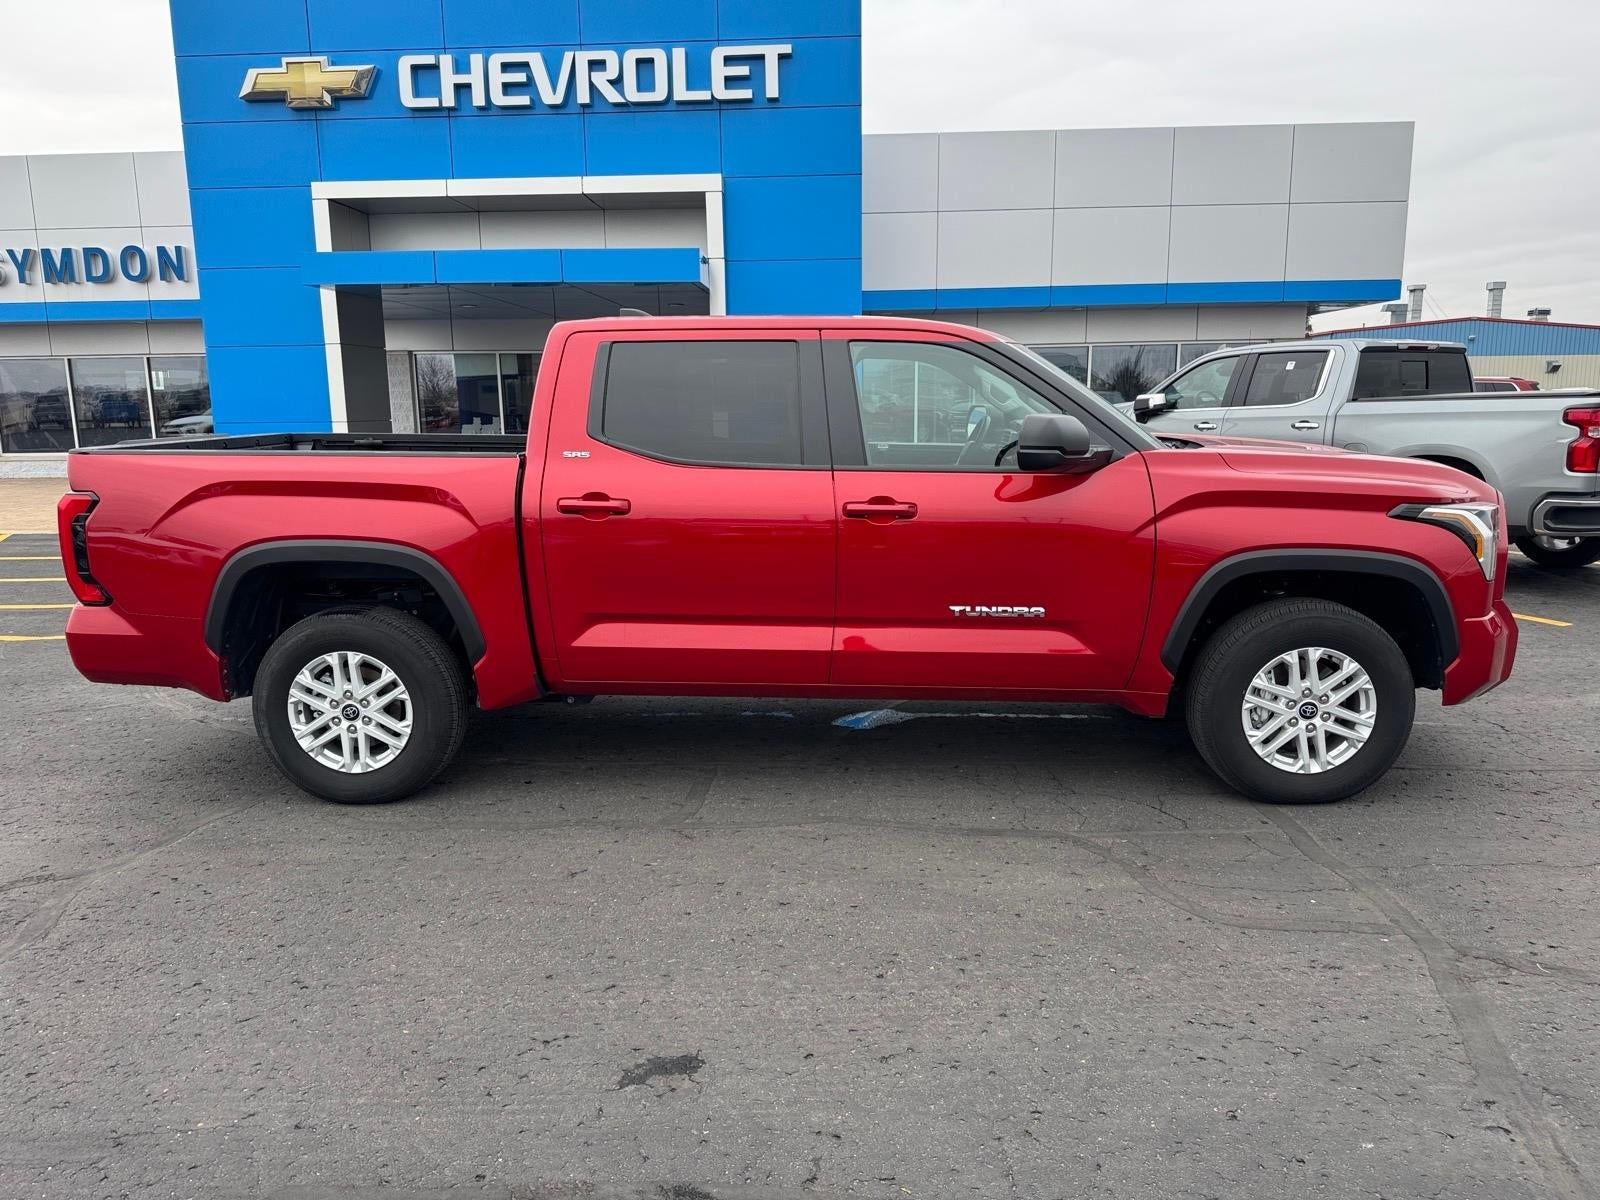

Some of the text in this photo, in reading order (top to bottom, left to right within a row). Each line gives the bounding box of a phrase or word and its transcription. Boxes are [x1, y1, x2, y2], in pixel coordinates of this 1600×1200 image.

[398, 44, 793, 109] CHEVROLET
[0, 245, 188, 286] YMDON
[948, 605, 1046, 618] TUNDRA
